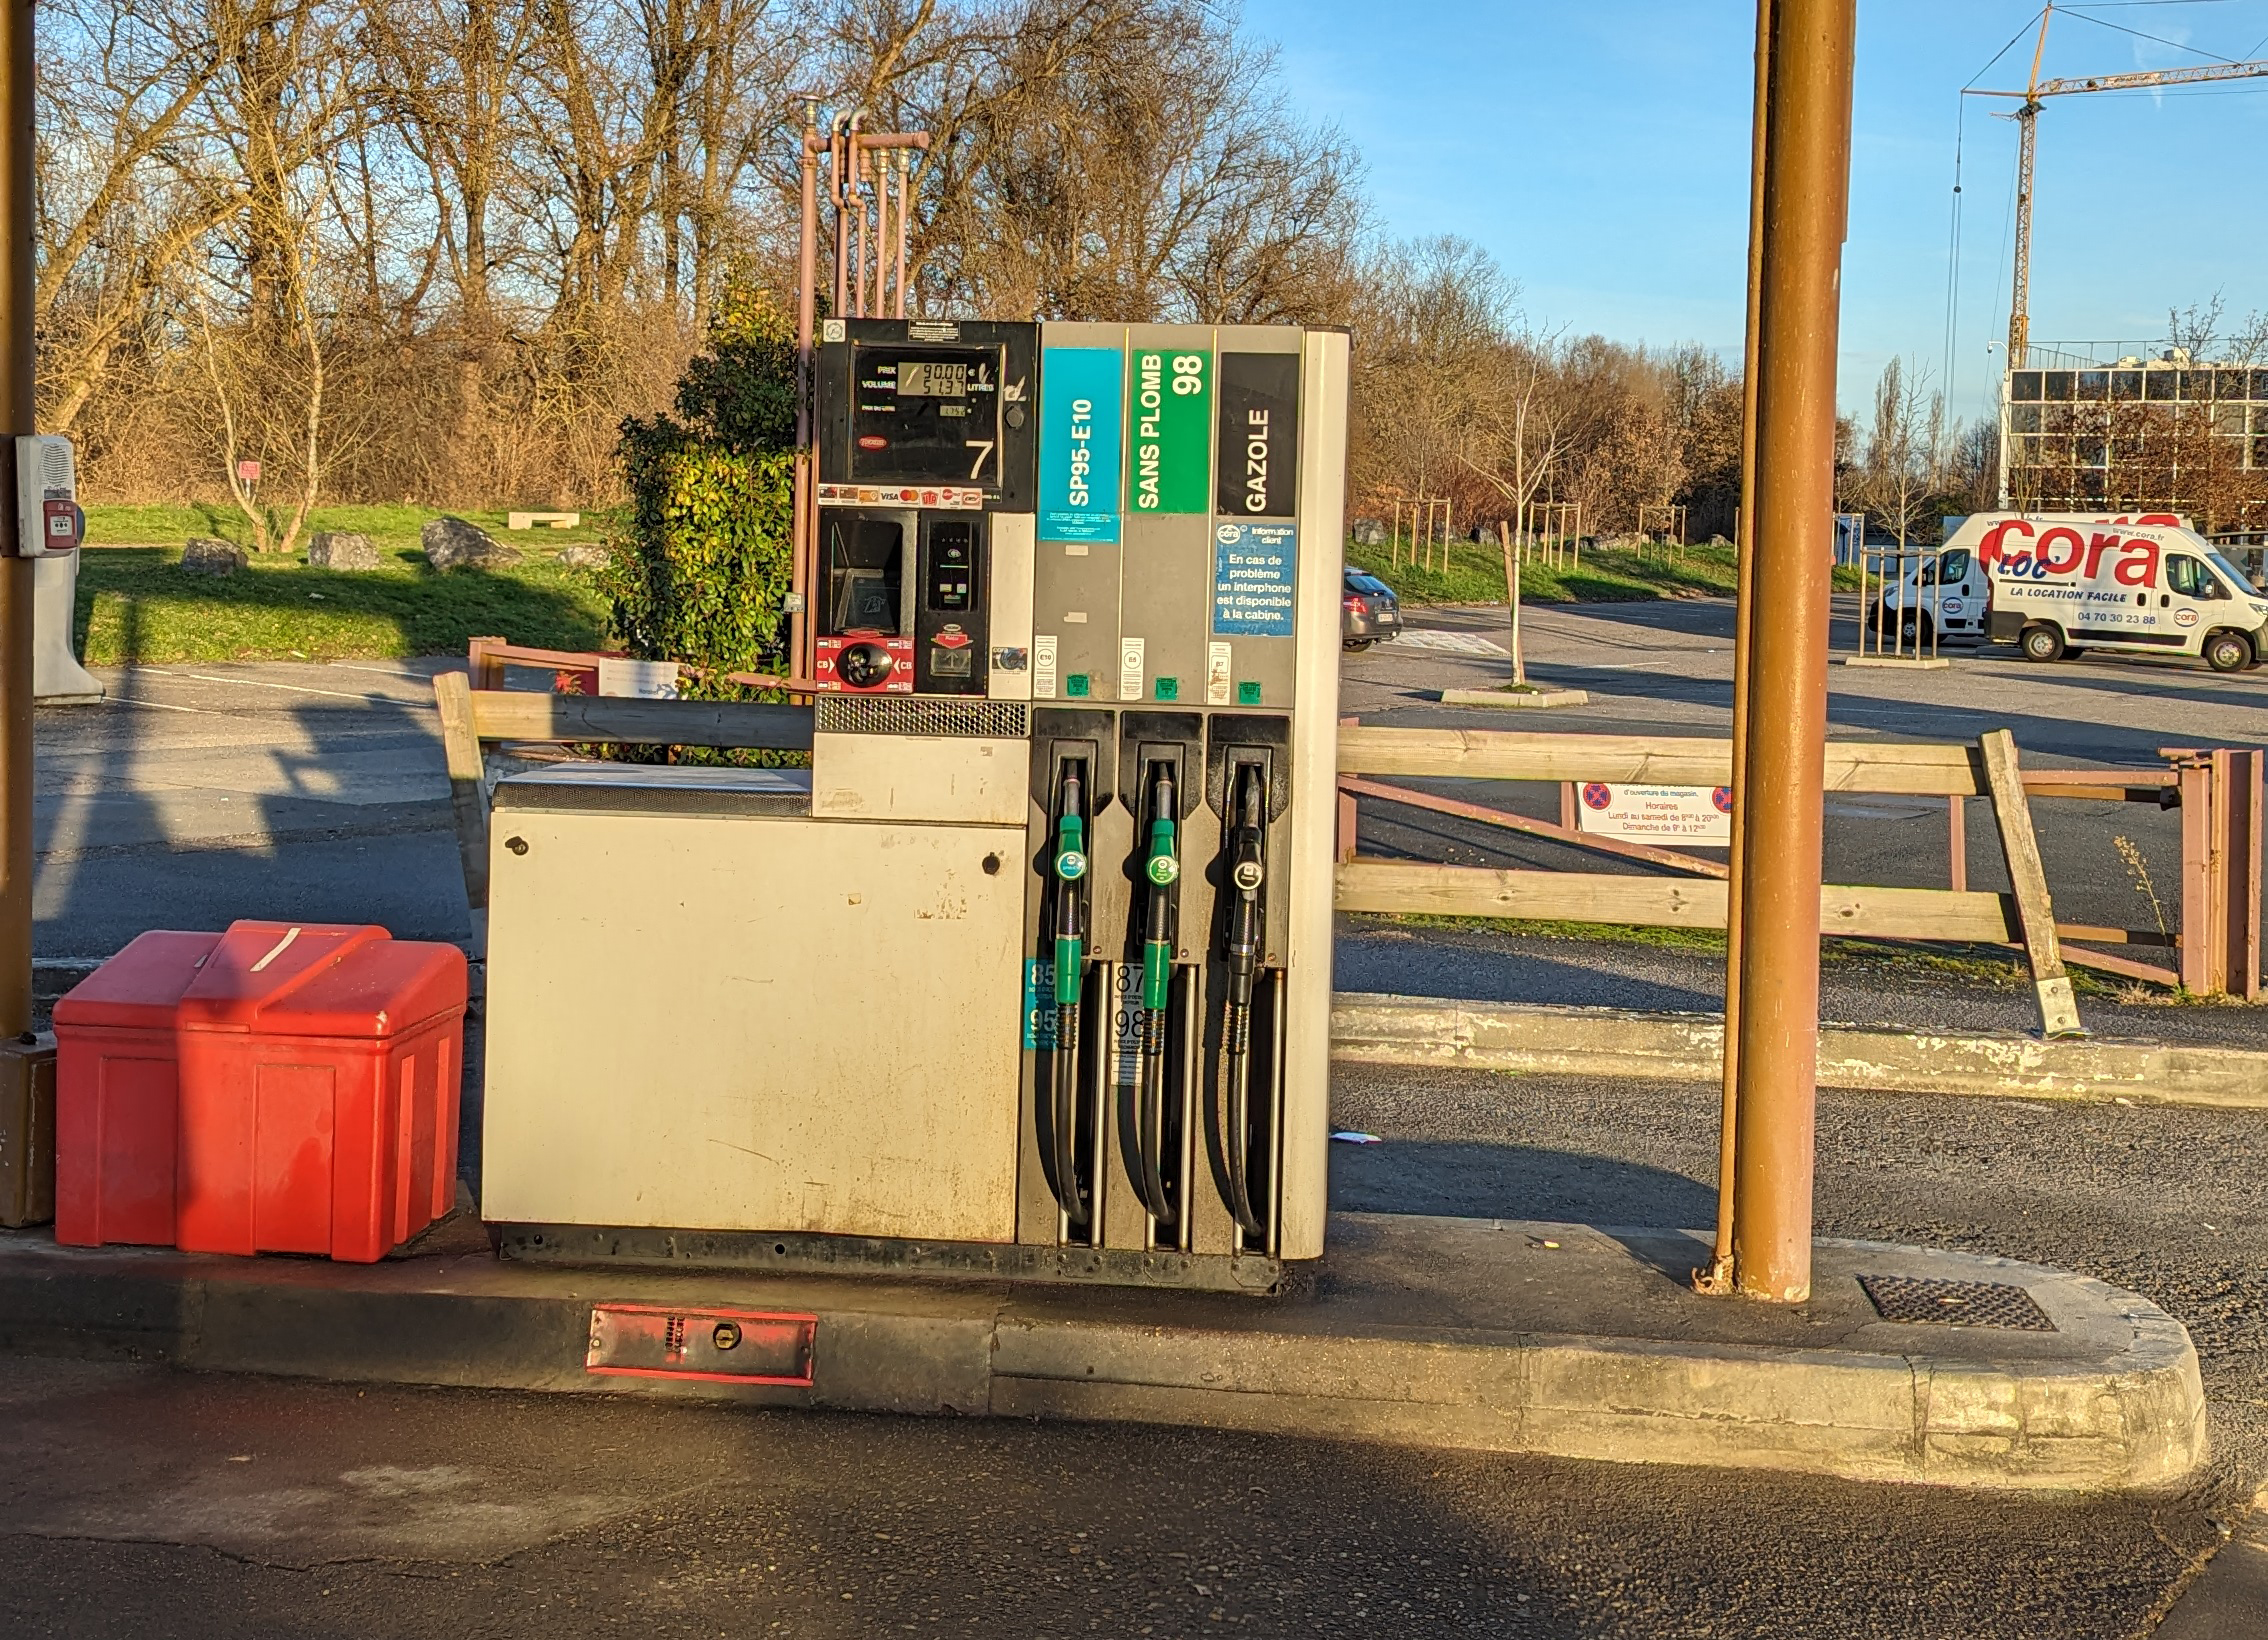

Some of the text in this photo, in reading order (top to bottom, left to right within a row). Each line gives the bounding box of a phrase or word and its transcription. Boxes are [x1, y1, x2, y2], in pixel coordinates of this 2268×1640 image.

[877, 366, 897, 374] PRIX
[1172, 355, 1203, 395] 98
[861, 380, 897, 390] VOLUME
[1138, 354, 1162, 509] SANS PLOMB
[1069, 398, 1092, 508] SP95-E10
[965, 440, 994, 480] 7
[1245, 409, 1269, 512] GAZOLE
[881, 493, 899, 501] VISA
[1251, 527, 1294, 536] Information
[2112, 527, 2165, 541] www.cora.fr
[1261, 537, 1282, 545] client
[1229, 554, 1283, 565] En cas de
[1992, 520, 2160, 589] cora
[1229, 568, 1281, 580] problème
[1217, 582, 1292, 594] un interphone
[1216, 595, 1292, 607] est disponible
[2010, 587, 2127, 603] LA LOCATION FACILE
[1222, 607, 1284, 621] à la cabine.
[2078, 612, 2156, 625] 04 70 30 23 88
[2175, 613, 2198, 622] cora
[816, 660, 829, 669] CB
[900, 661, 913, 670] CB
[1645, 802, 1679, 810] Horaires
[1608, 811, 1629, 820] Lundi
[1641, 813, 1668, 821] samedi
[1669, 813, 1680, 822] de
[1622, 822, 1660, 831] Dimanche
[1661, 823, 1671, 831] de
[1031, 964, 1055, 985] 85
[1116, 965, 1144, 993] 87
[1030, 1009, 1057, 1031] 95
[1115, 1009, 1145, 1038] 98
